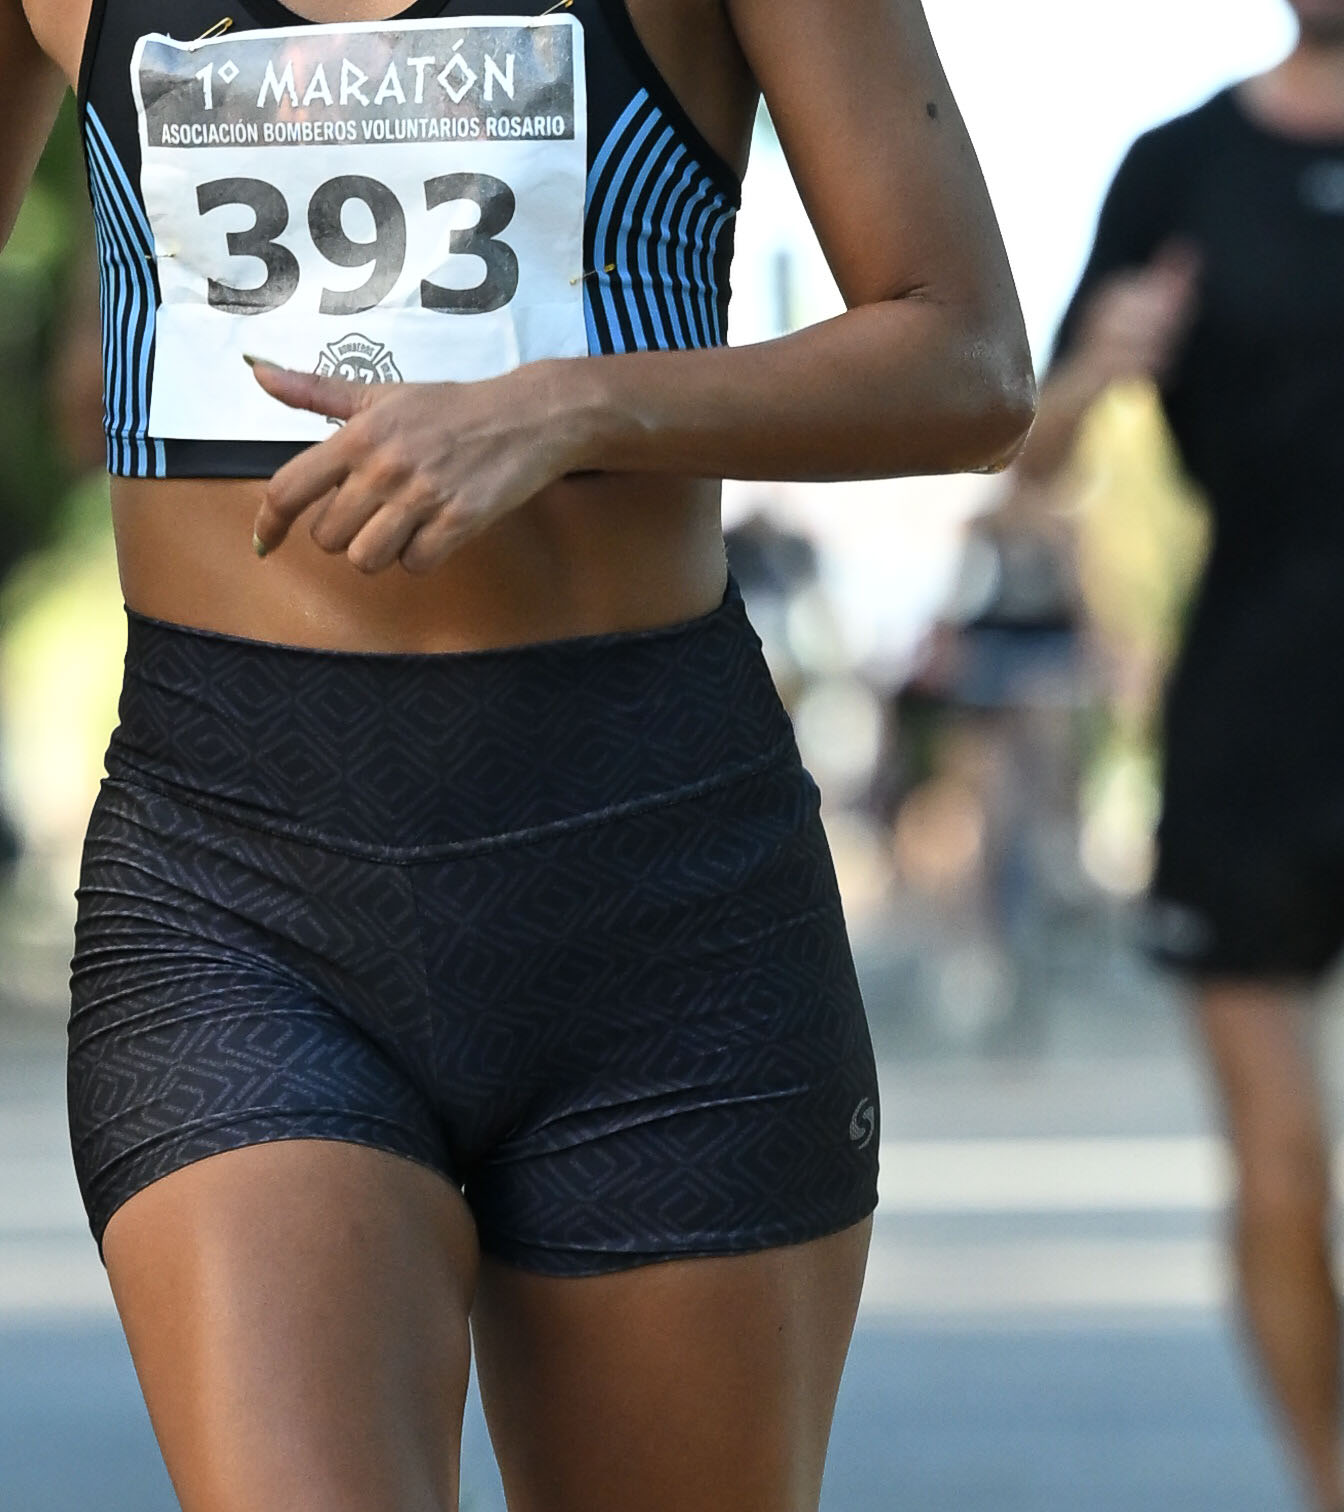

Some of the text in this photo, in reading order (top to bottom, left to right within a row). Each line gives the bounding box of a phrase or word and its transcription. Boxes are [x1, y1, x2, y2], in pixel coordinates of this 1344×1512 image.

[256, 38, 515, 110] MARATÓN
[161, 115, 566, 145] ASOCIACIÓN BOMBEROS VOLUNTARIOS ROSARIO
[195, 171, 520, 317] 393
